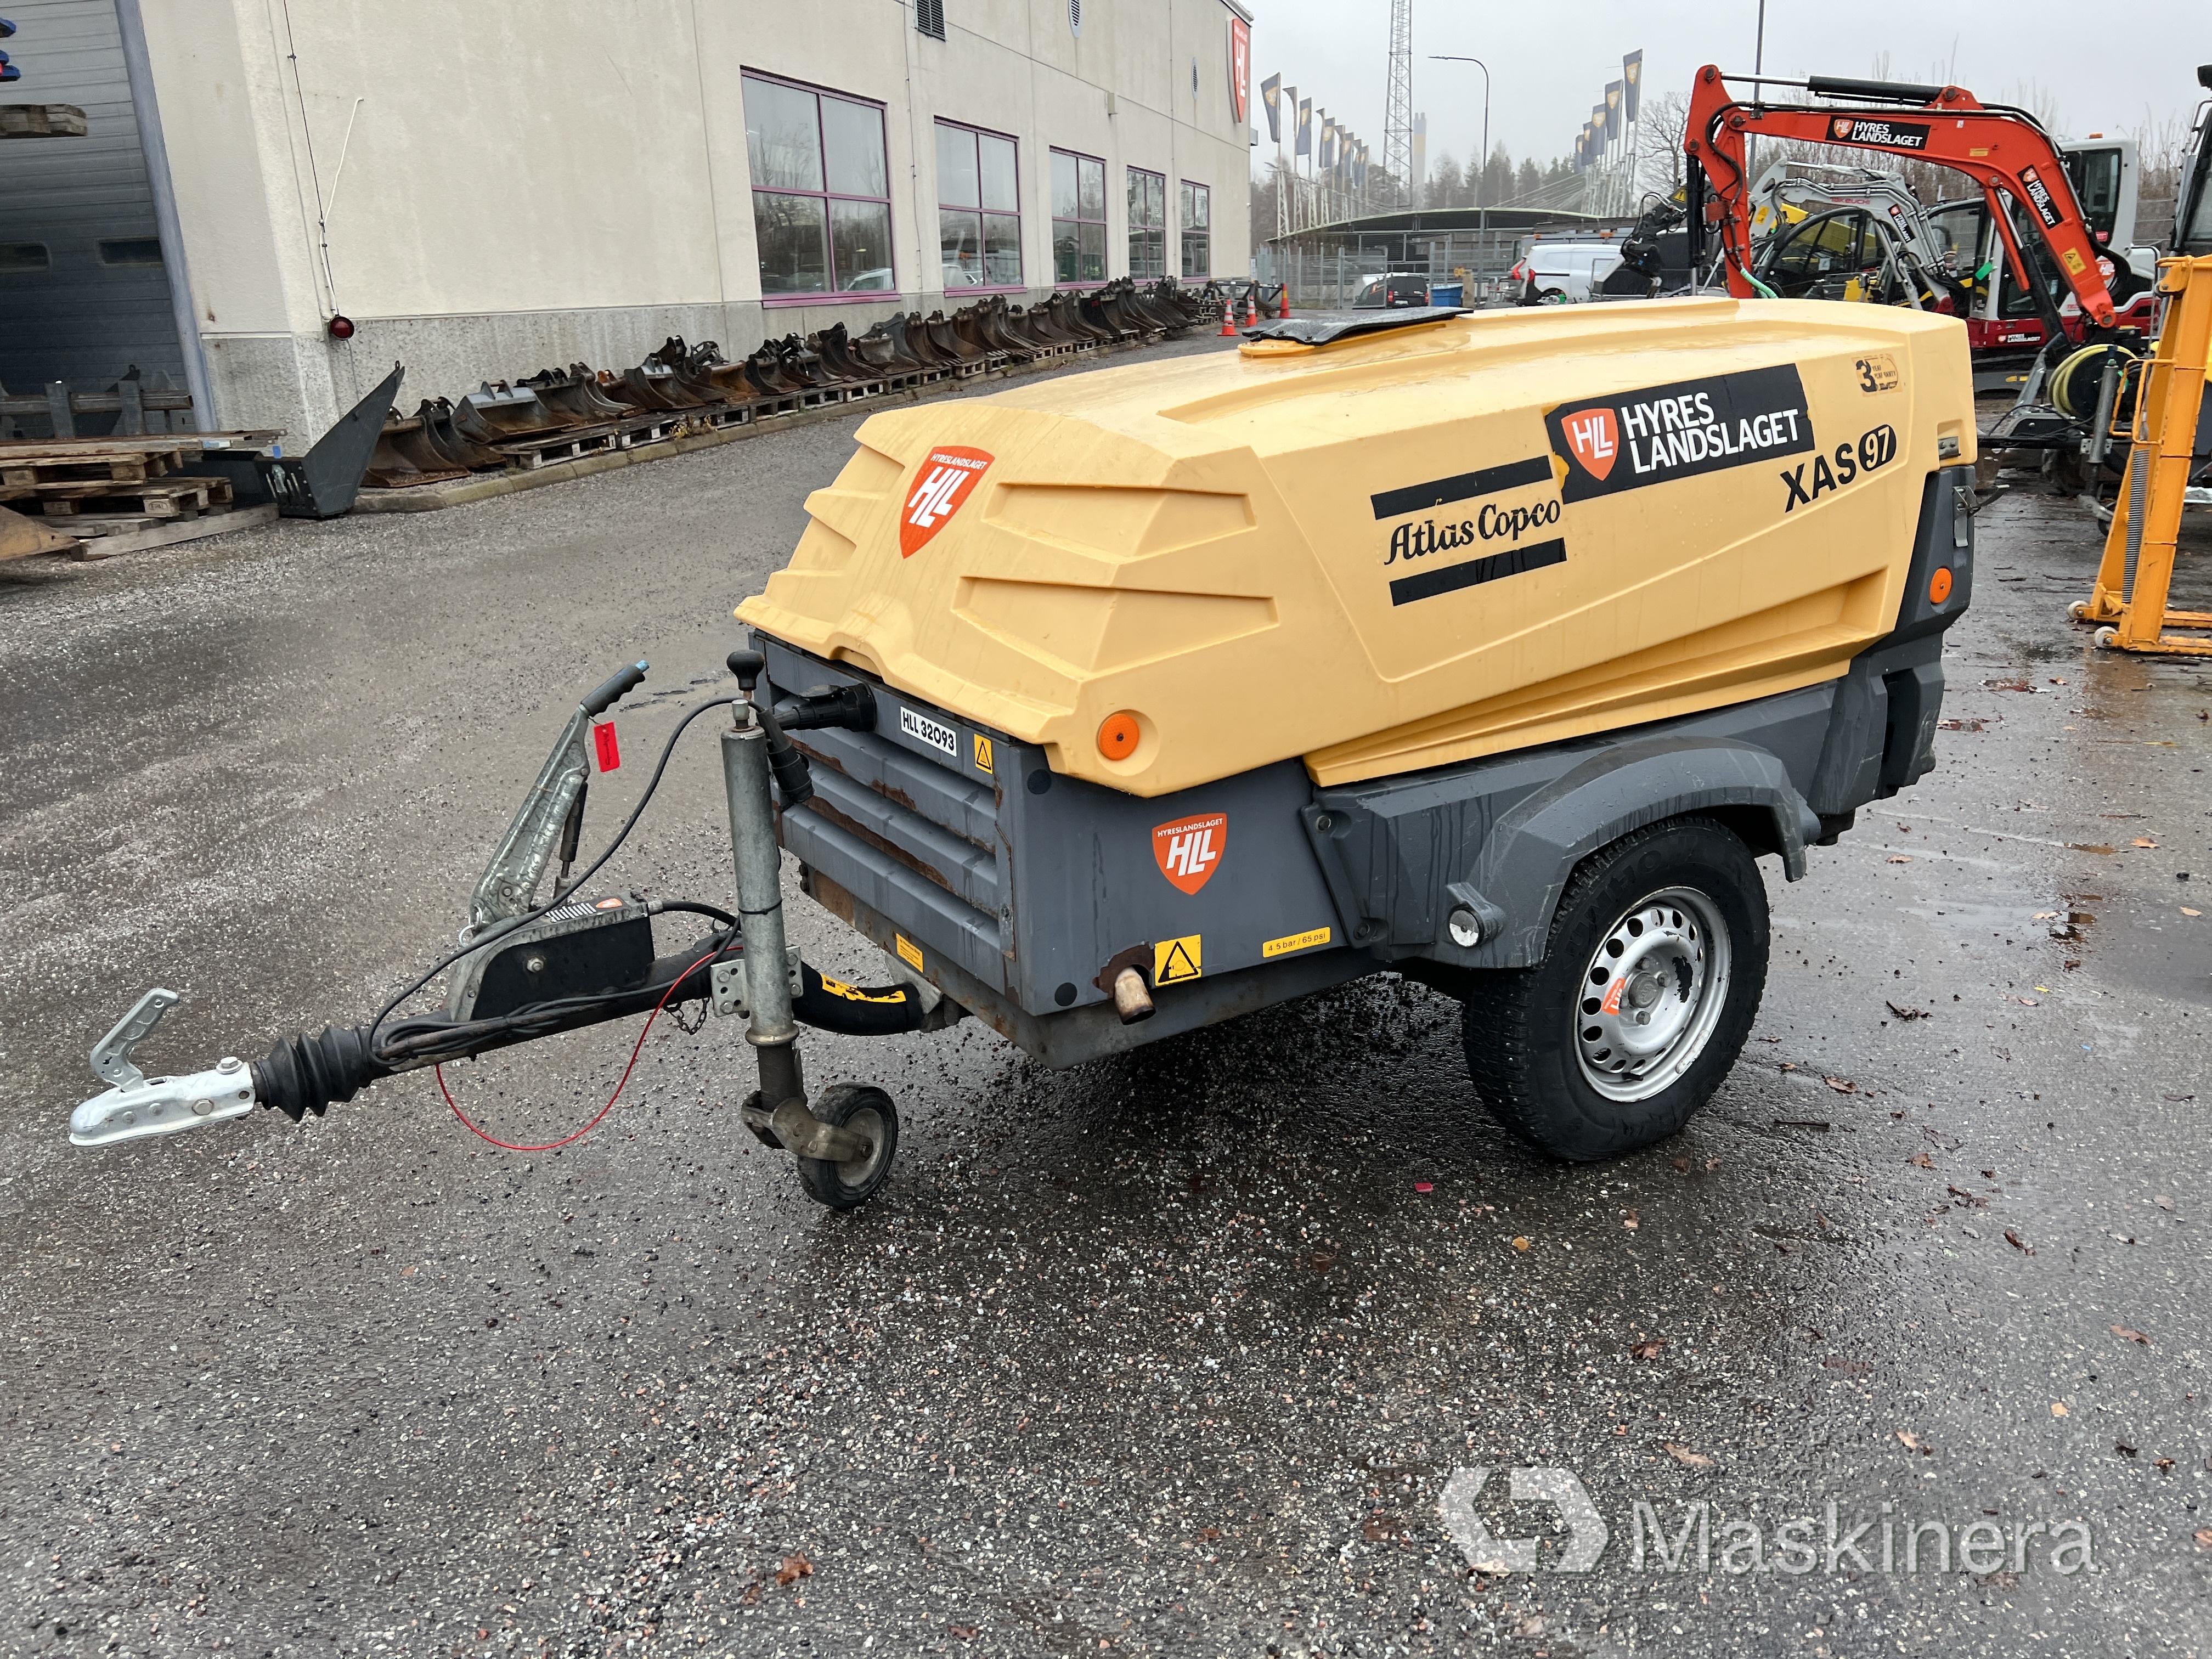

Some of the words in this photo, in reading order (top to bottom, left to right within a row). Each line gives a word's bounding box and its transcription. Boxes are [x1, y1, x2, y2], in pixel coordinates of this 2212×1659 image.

[1851, 131, 1923, 147] LANDSLAGET
[1854, 121, 1890, 134] HYRES
[1856, 360, 1877, 392] 3
[1621, 392, 1714, 439] HYRES
[1571, 416, 1613, 459] HLL
[1629, 409, 1799, 474] LANDSLAGET
[930, 453, 988, 470] HYRESLANDSLAGET
[1780, 443, 1857, 514] XAS
[1865, 426, 1891, 469] 97
[907, 466, 970, 528] HLL
[1384, 520, 1475, 566] Atlas
[1478, 500, 1561, 541] Copco
[902, 711, 919, 734] HLL
[921, 720, 954, 751] 32093
[1157, 817, 1223, 838] HYRESLANDSLAGET
[1166, 828, 1217, 877] HLL
[1283, 940, 1296, 949] bar
[1302, 935, 1312, 944] 65
[1314, 931, 1325, 942] psi
